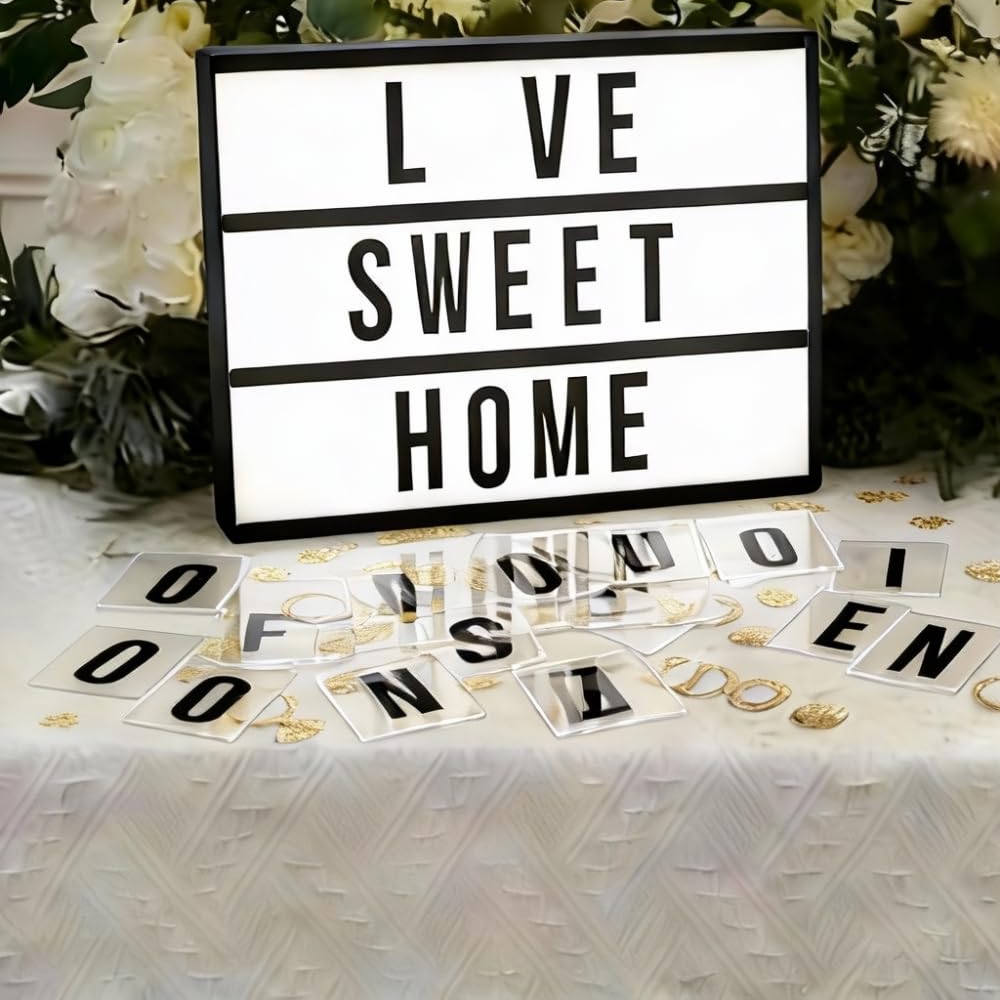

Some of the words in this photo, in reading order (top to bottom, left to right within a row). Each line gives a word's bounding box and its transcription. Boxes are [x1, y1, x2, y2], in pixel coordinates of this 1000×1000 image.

[347, 223, 674, 342] SWEET
[394, 371, 649, 493] HOME
[739, 527, 799, 568] O
[145, 563, 218, 605] O
[242, 612, 288, 653] F
[448, 616, 513, 664] S
[812, 600, 888, 652] E
[74, 639, 160, 685] O
[885, 622, 976, 680] N
[171, 675, 252, 723] O
[359, 667, 445, 720] N
